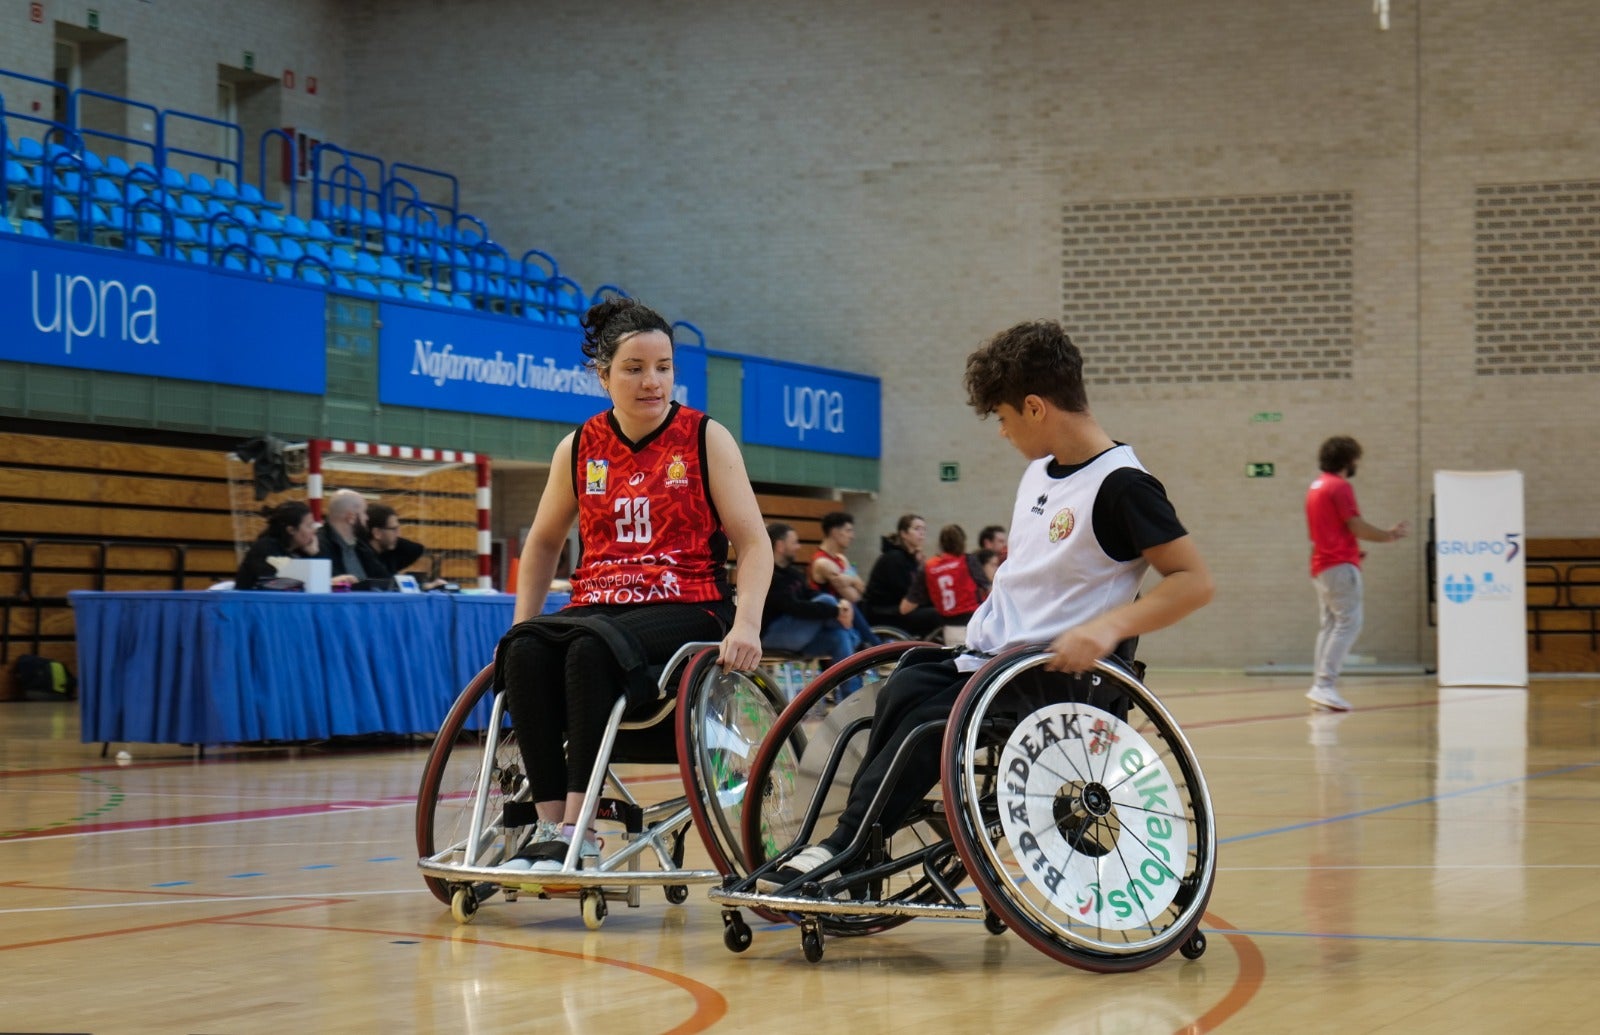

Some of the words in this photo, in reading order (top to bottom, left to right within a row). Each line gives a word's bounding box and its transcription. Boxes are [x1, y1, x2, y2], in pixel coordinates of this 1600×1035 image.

[32, 269, 160, 354] upna
[784, 385, 844, 441] upna
[614, 497, 652, 543] 28
[580, 573, 646, 591] ORTOPEDIA
[938, 575, 956, 611] 6
[1108, 747, 1175, 918] elkarbus
